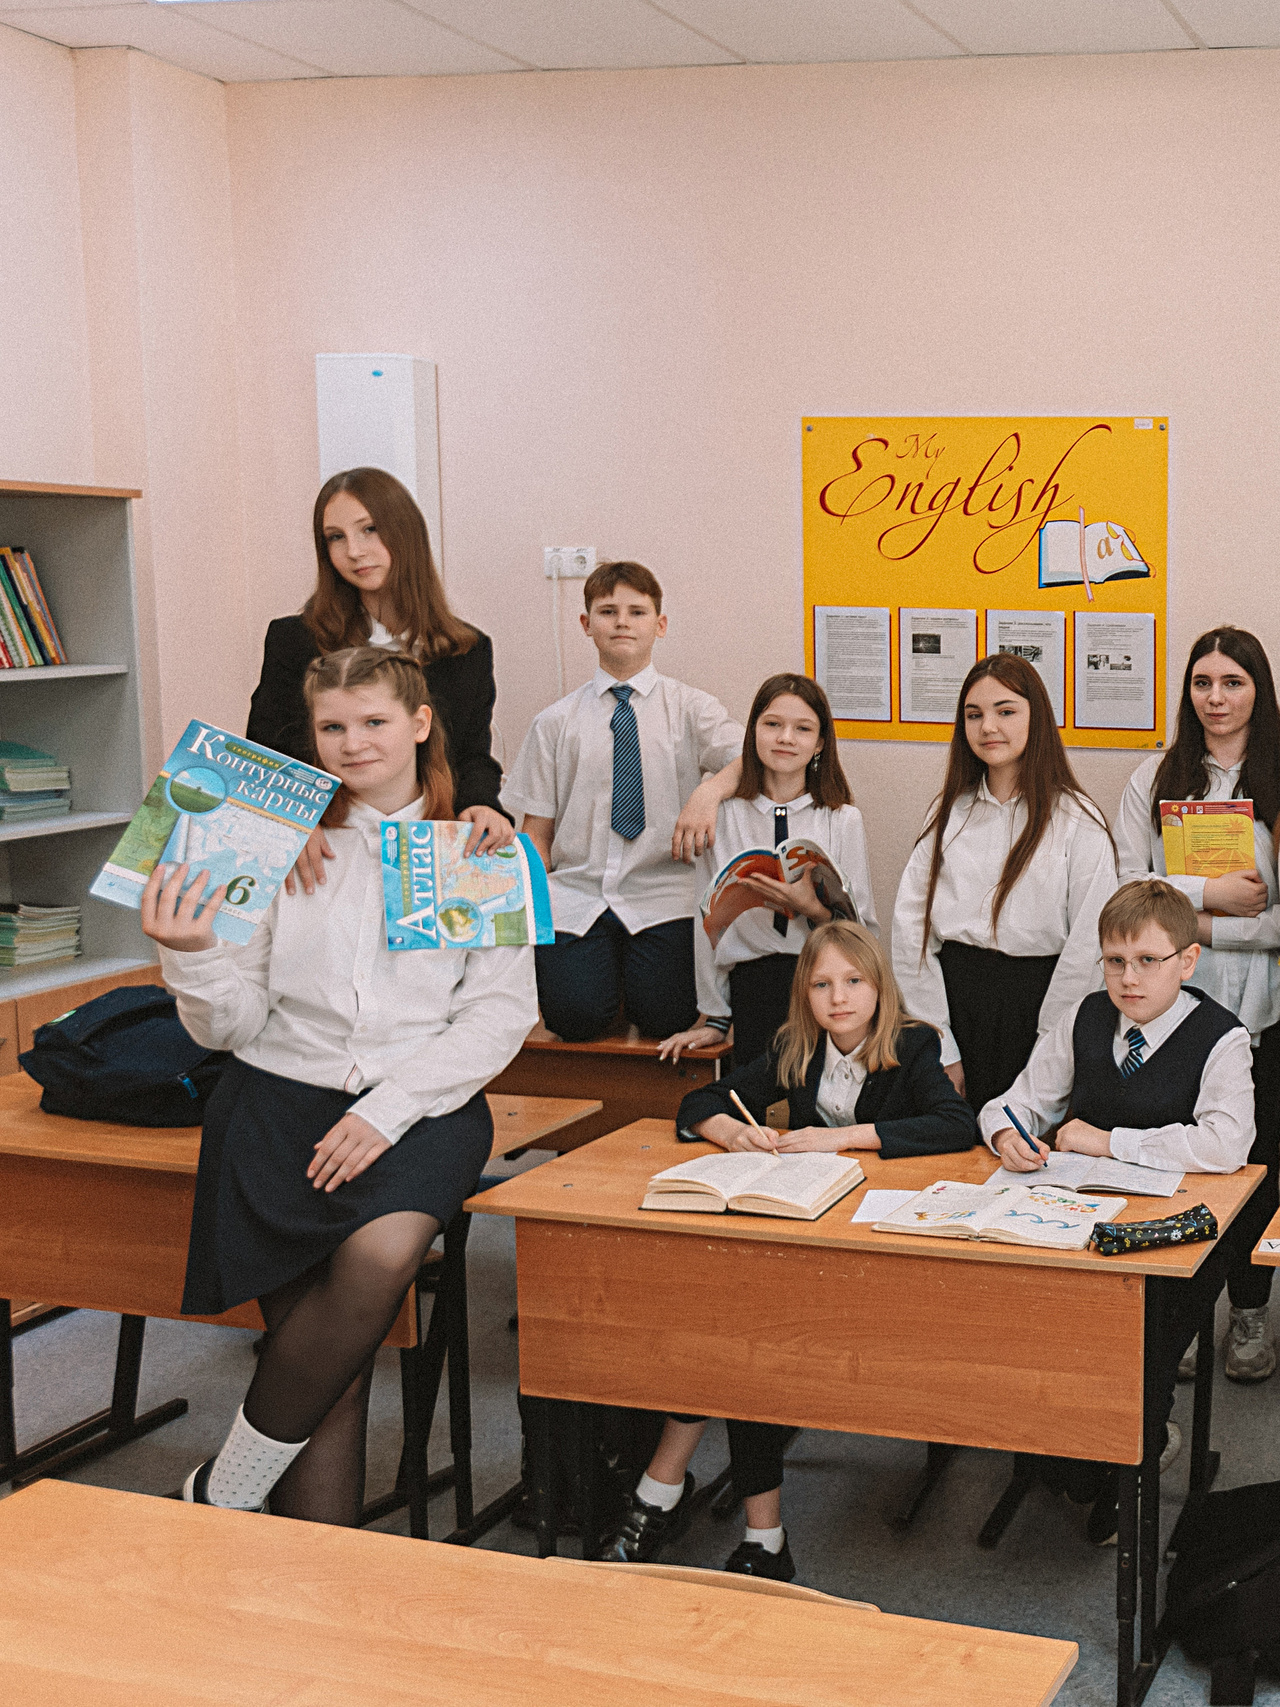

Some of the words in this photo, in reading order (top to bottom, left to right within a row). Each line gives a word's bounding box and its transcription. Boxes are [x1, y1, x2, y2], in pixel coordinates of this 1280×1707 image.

[896, 432, 946, 479] My
[819, 423, 1112, 574] English
[187, 726, 329, 806] Контурные
[235, 780, 319, 822] карты
[225, 874, 257, 906] 6
[396, 825, 438, 939] Атлас
